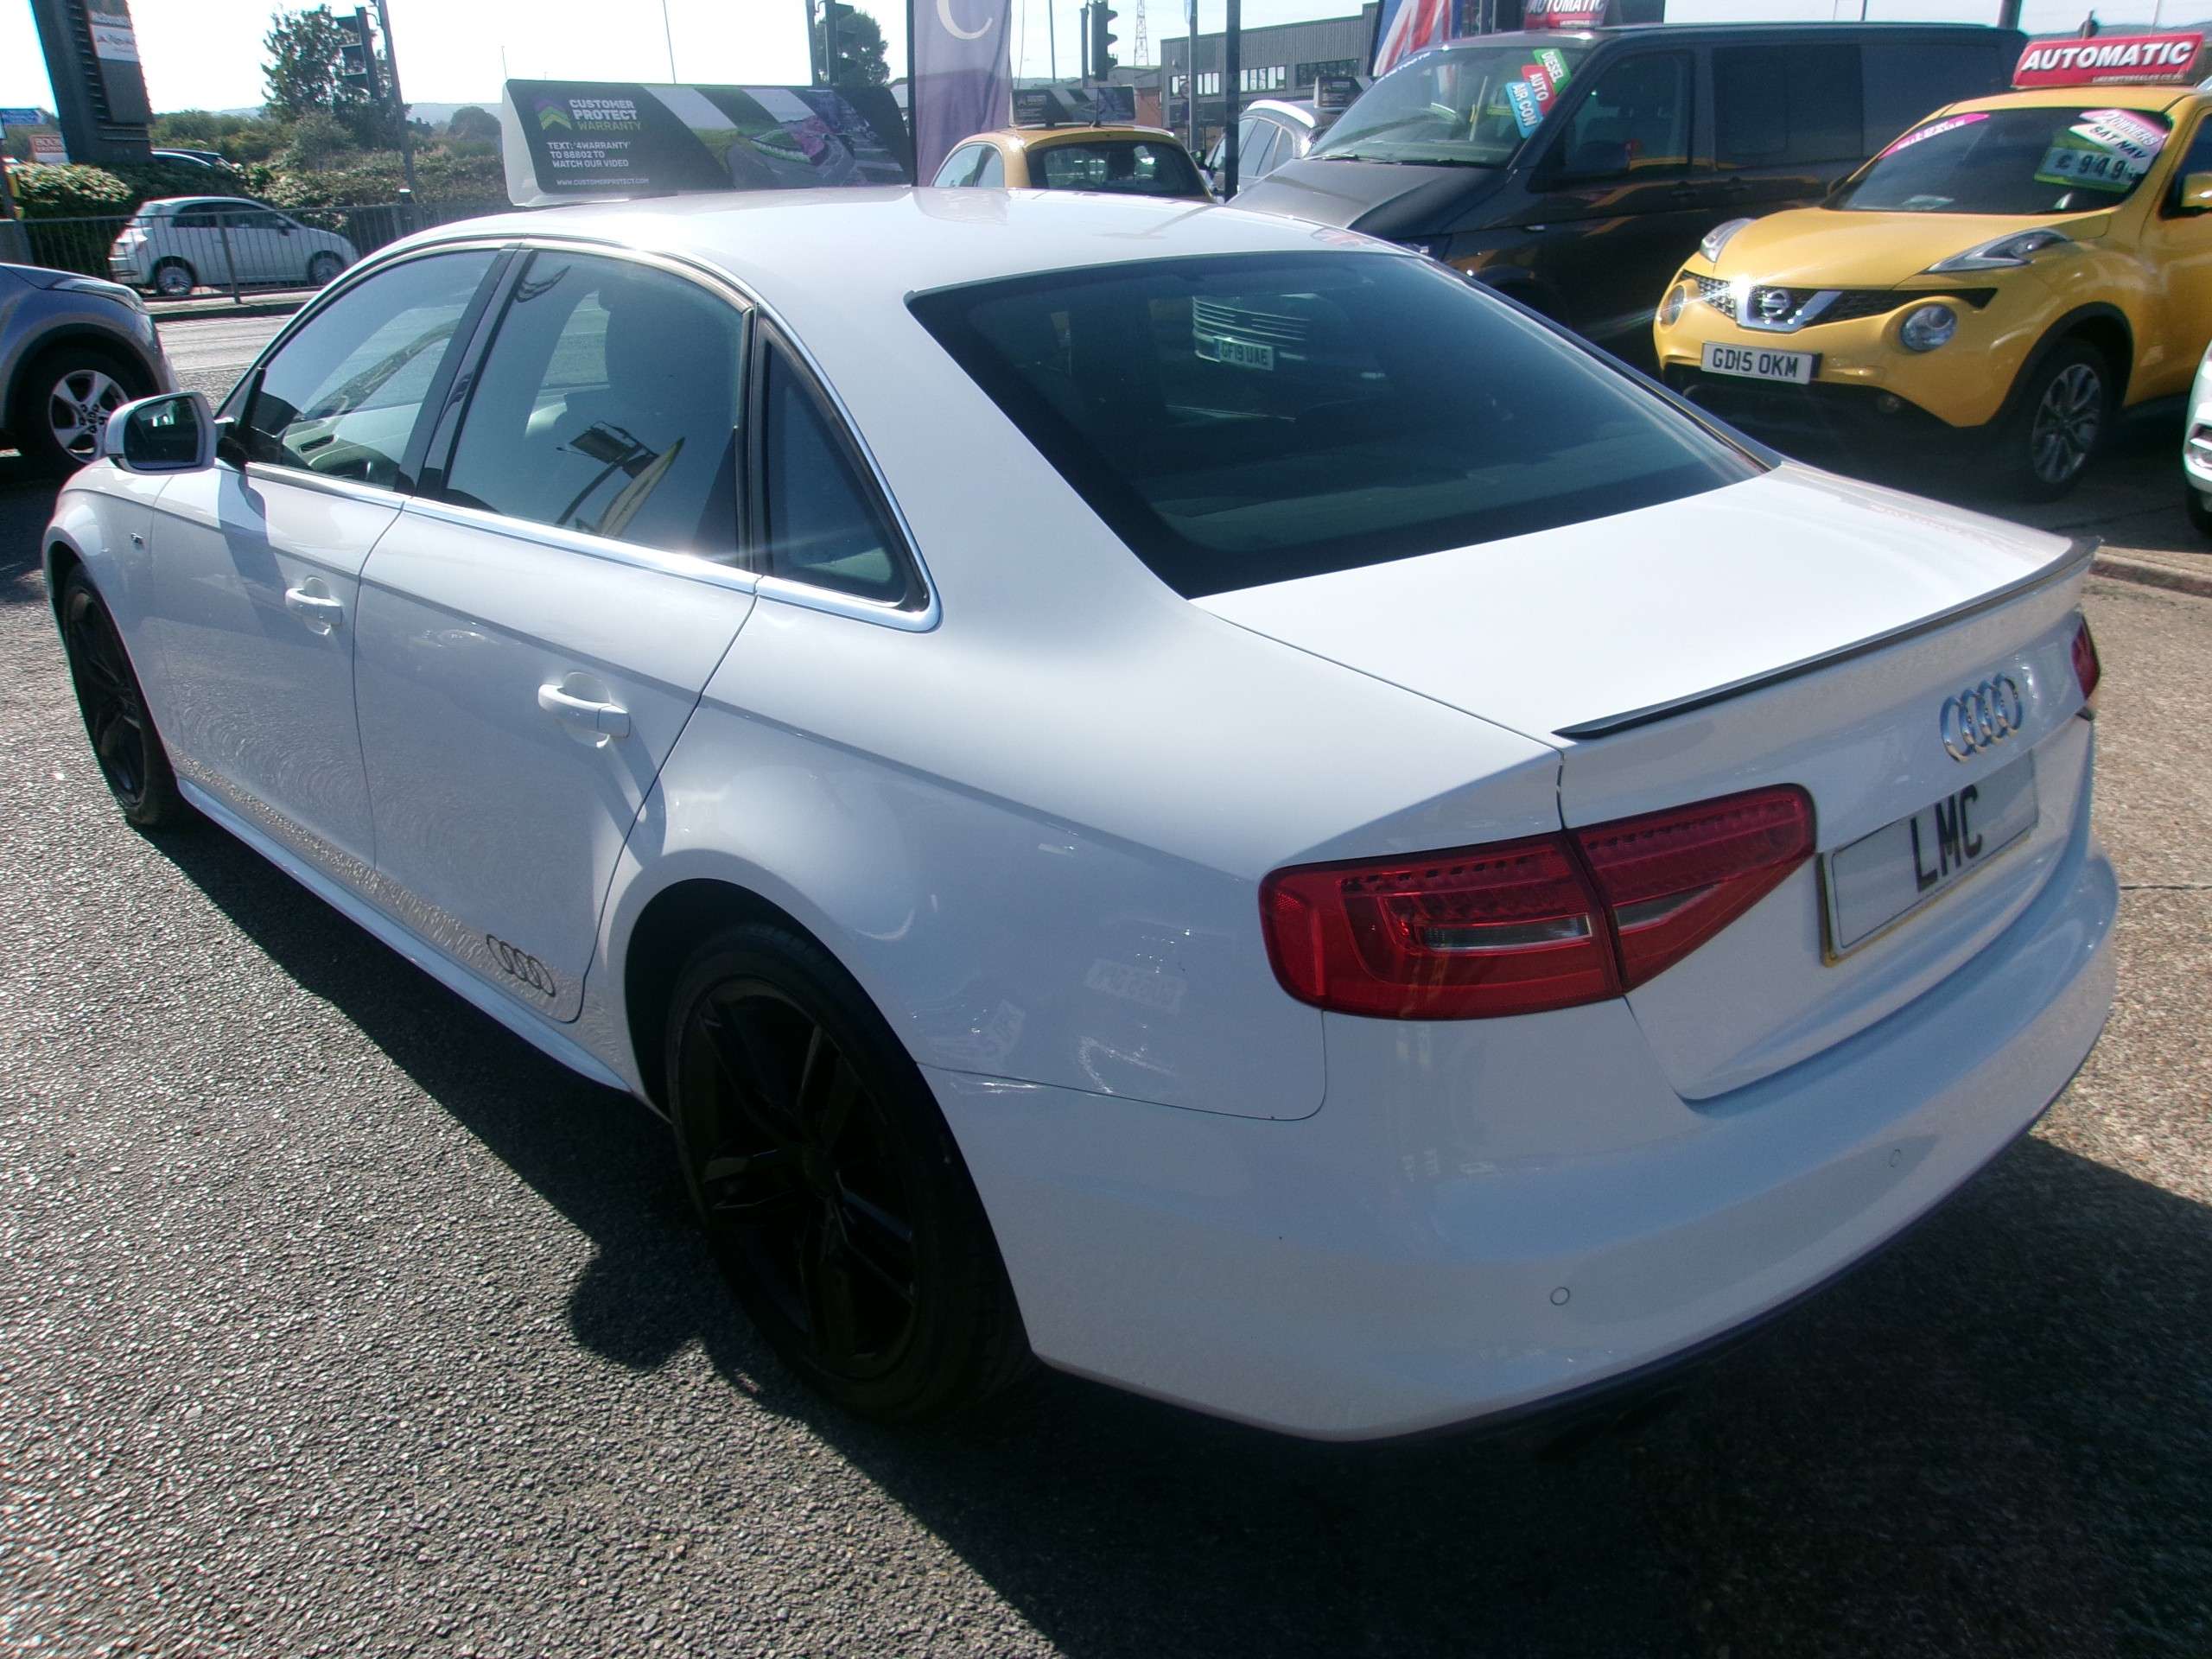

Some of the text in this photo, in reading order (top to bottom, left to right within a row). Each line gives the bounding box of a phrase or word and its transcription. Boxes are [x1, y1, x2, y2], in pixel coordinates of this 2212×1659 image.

[1541, 51, 1564, 83] DIESEL
[2020, 41, 2195, 72] AUTOMATIC
[1529, 73, 1549, 101] AUTO
[569, 99, 634, 109] CUSTOMER
[572, 110, 637, 120] PROTECT
[1512, 83, 1538, 126] AIR CON
[578, 121, 641, 130] WARRANTY
[2089, 125, 2147, 160] SAT NAV
[1713, 347, 1798, 378] GD15 OKM
[1910, 784, 1983, 892] LMC
